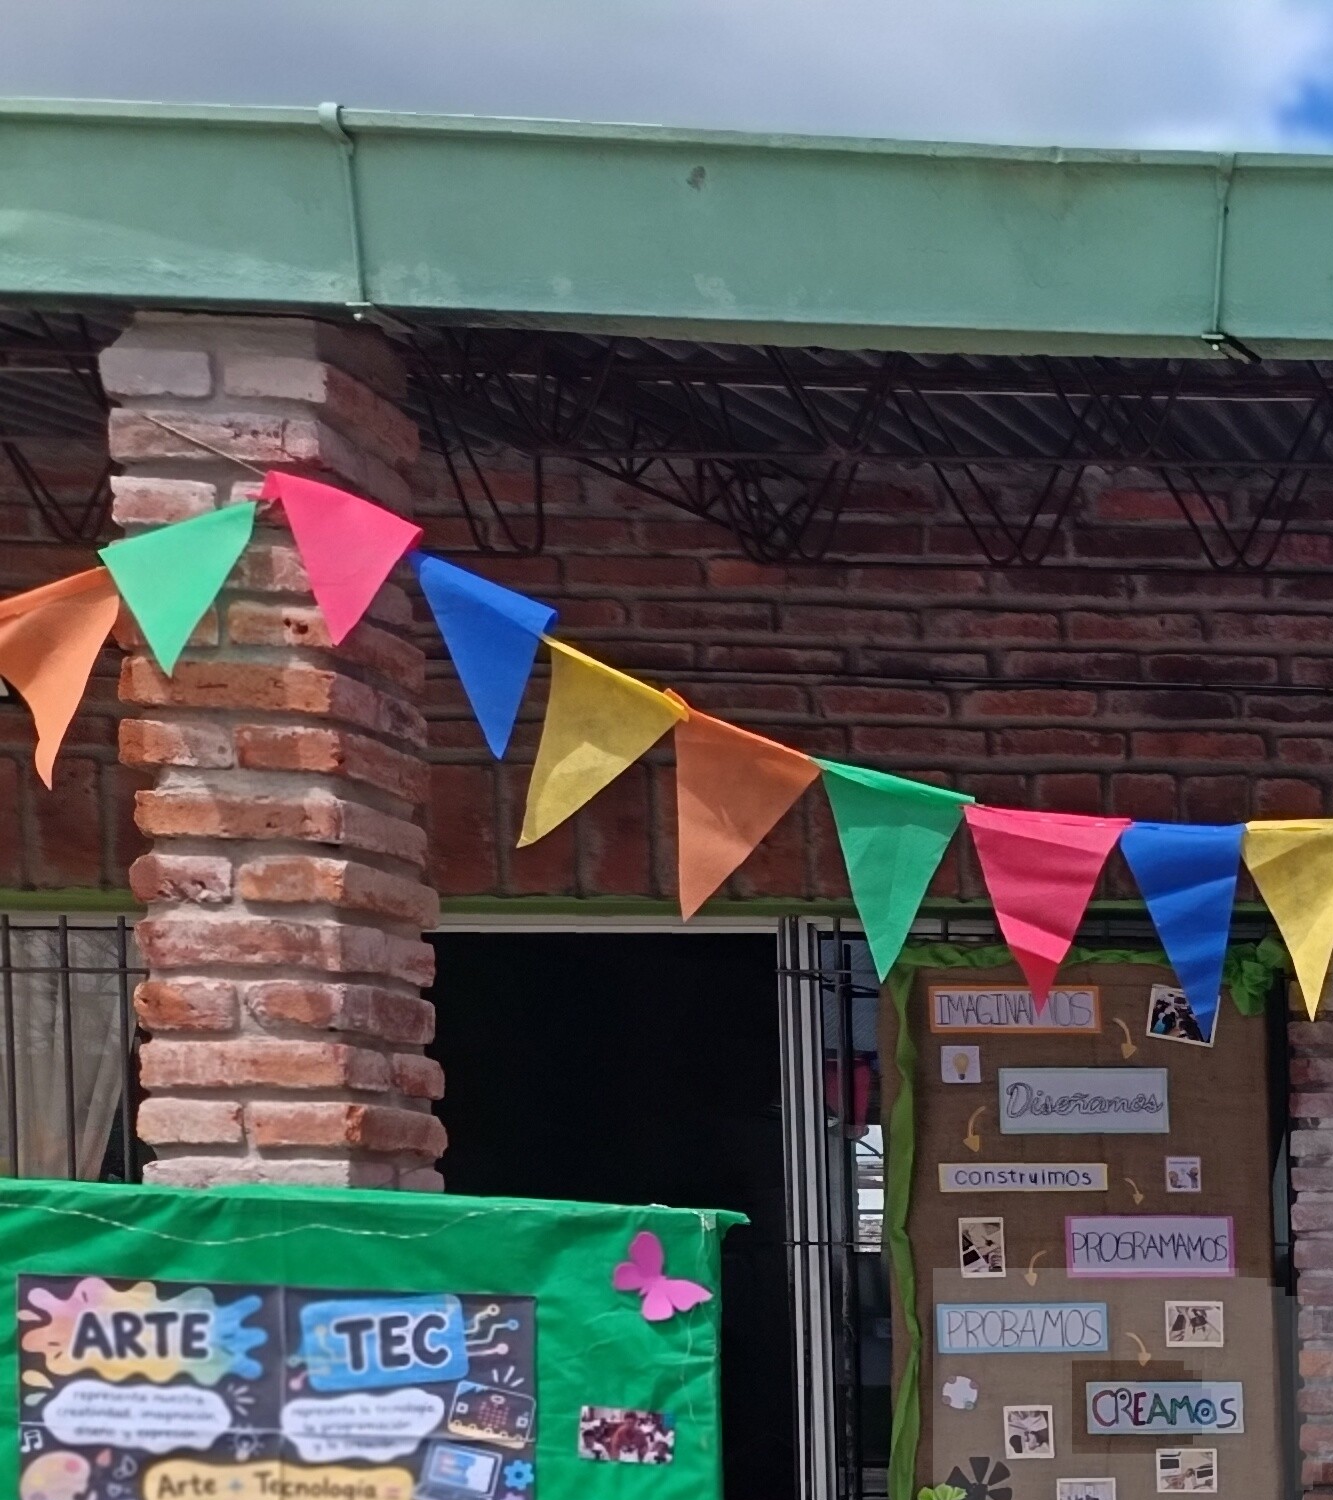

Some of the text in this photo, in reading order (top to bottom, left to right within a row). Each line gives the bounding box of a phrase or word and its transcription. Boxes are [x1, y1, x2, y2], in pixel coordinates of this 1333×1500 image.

[1006, 1082, 1164, 1118] Diseñamos
[1072, 1232, 1229, 1266] PROGRAMAMOS
[71, 1311, 451, 1370] ARTE TEC
[946, 1310, 1102, 1348] PROBAMOS
[1091, 1388, 1237, 1429] CREAMOS
[157, 1474, 216, 1499] Arte
